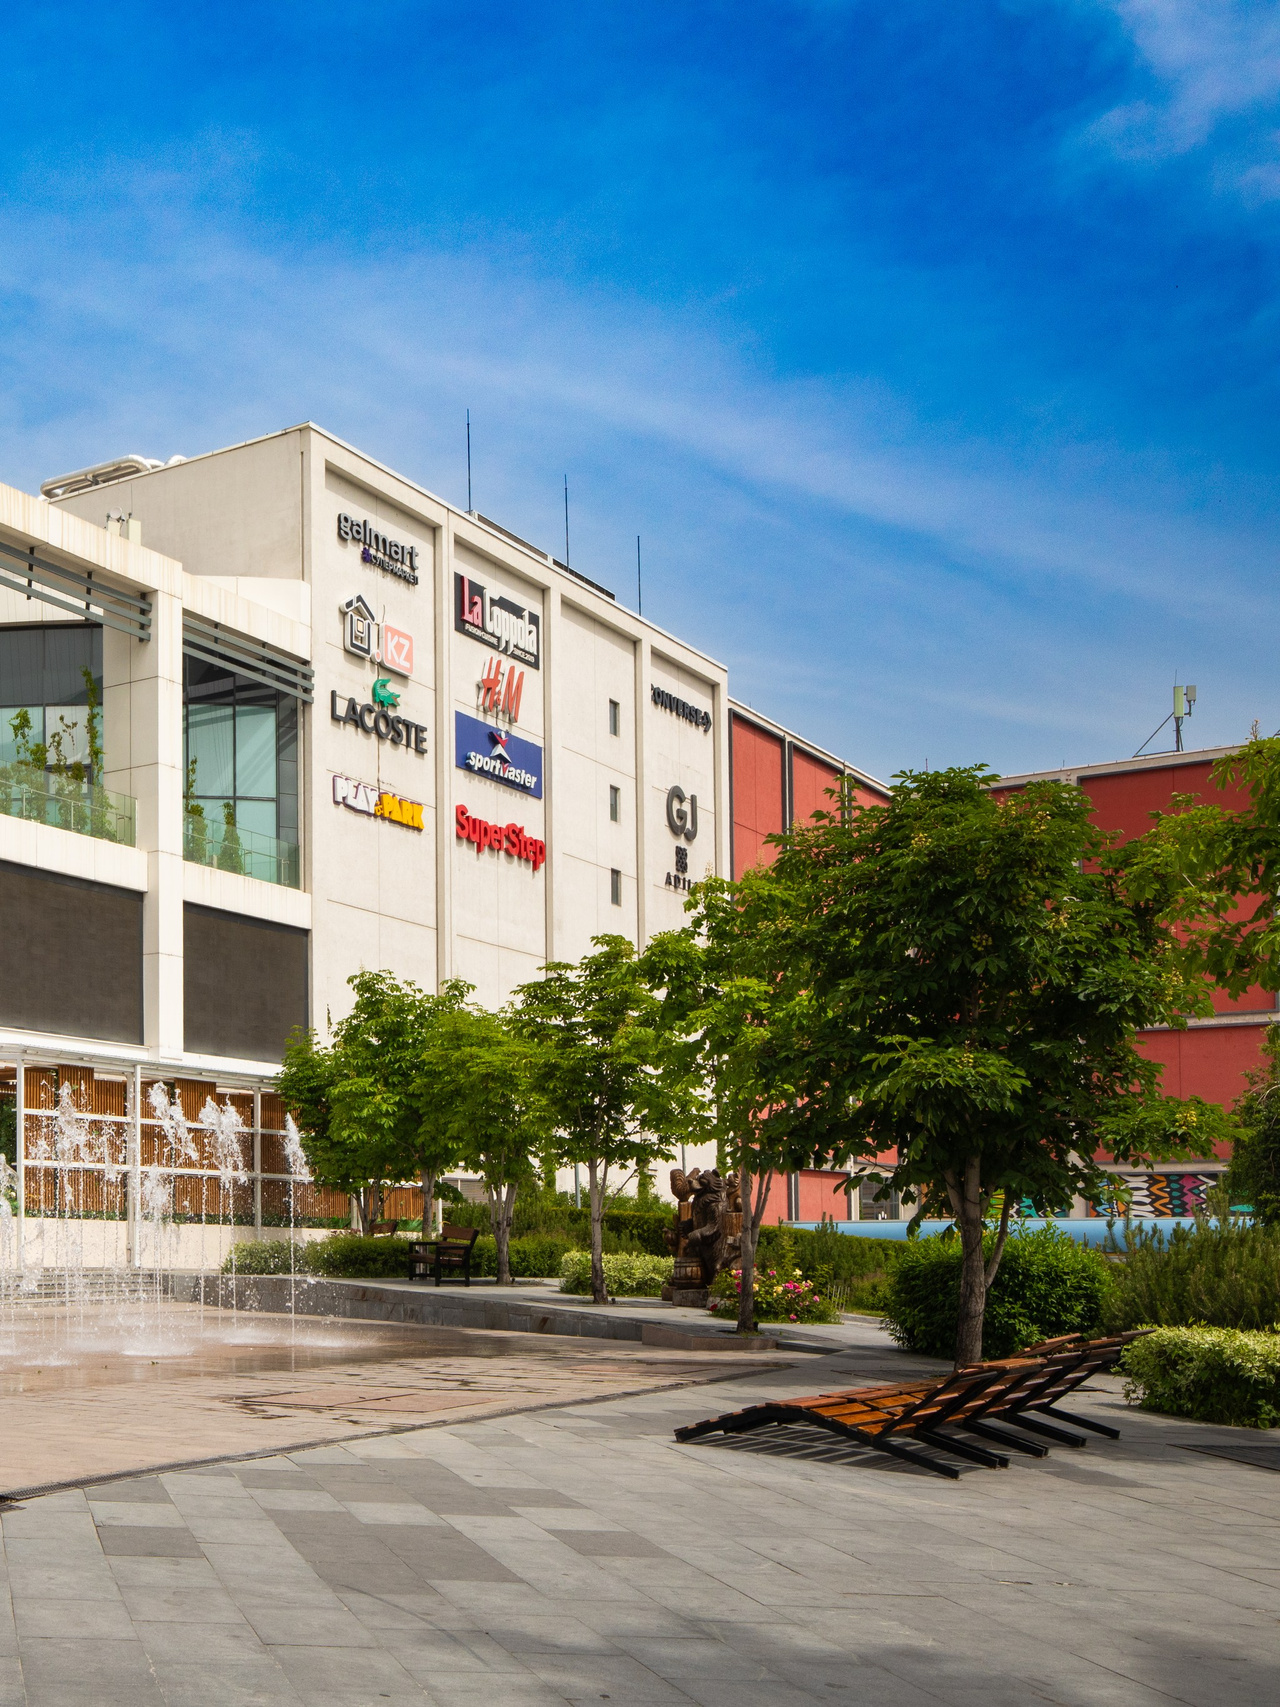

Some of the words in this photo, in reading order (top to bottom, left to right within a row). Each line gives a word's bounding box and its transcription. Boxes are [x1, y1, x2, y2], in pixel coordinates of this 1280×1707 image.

[337, 512, 419, 570] galmart
[370, 553, 418, 586] СУПЕРМАРКЕТ
[461, 575, 482, 628] La
[477, 656, 525, 723] H&M
[331, 690, 427, 754] LACOSTE
[467, 751, 537, 789] sportmaster
[333, 775, 378, 816] PLAY
[380, 792, 425, 831] PARK
[666, 785, 697, 841] GJ
[456, 804, 545, 871] SuperStep
